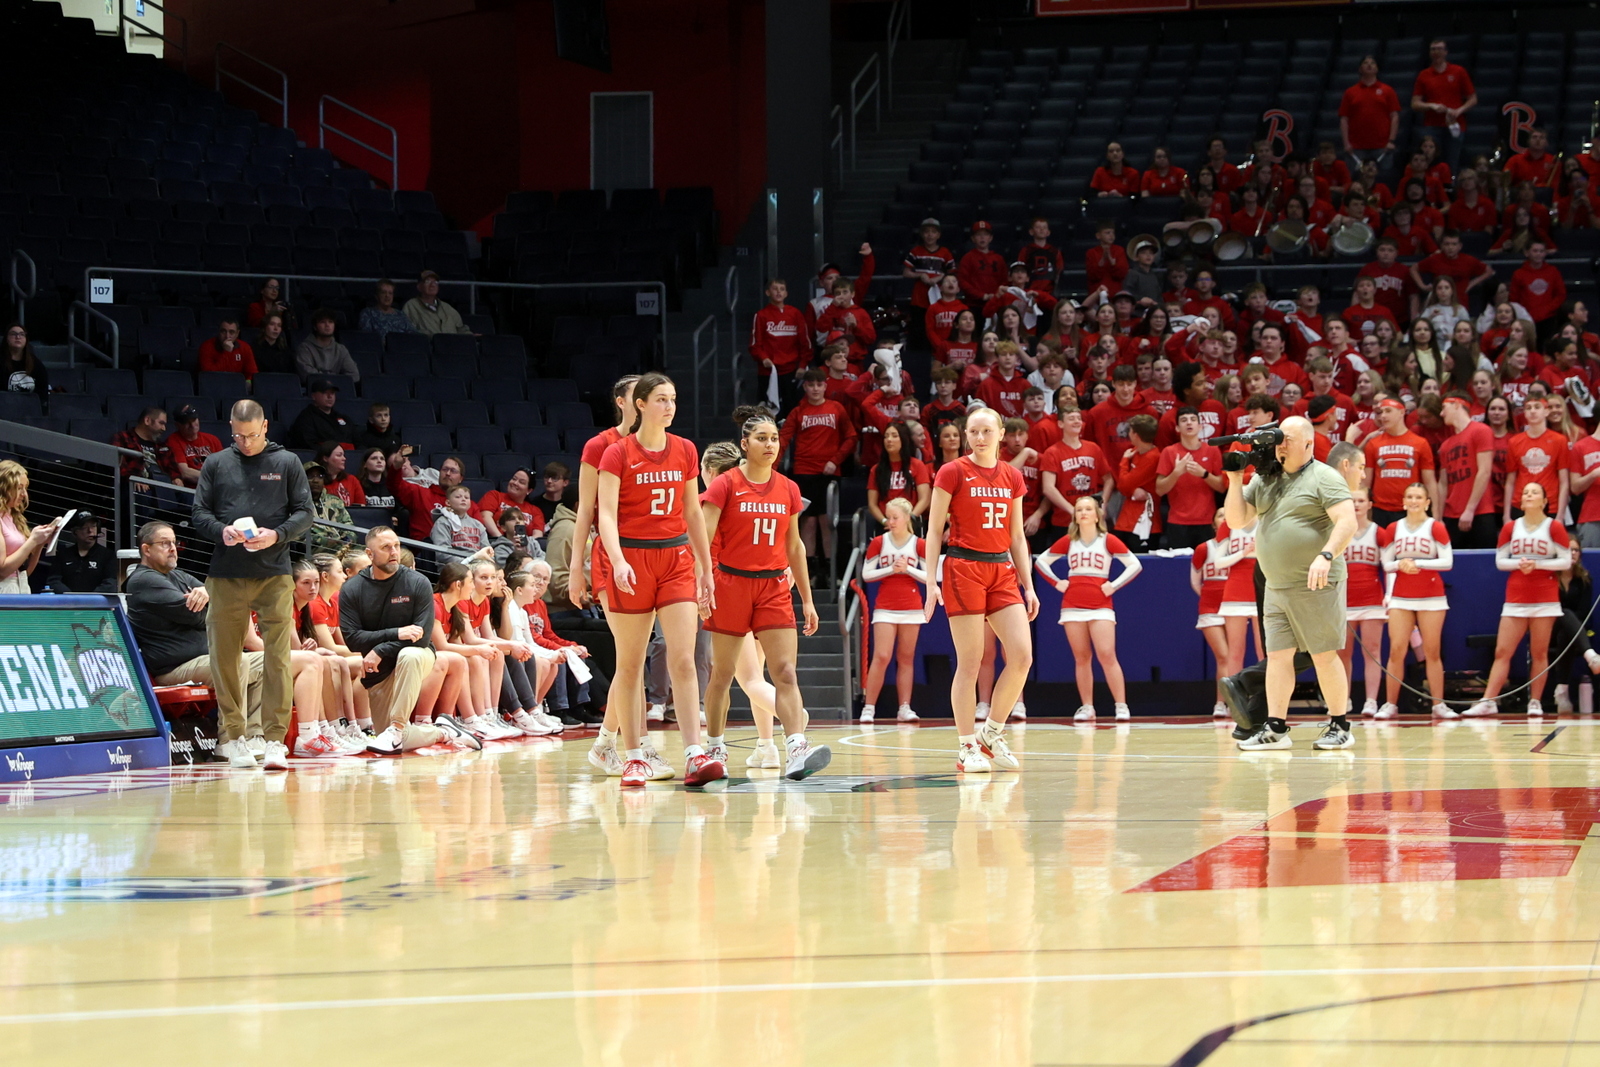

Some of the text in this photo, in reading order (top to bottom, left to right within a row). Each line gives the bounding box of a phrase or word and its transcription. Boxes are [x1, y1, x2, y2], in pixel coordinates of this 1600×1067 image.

[94, 286, 110, 295] 107
[639, 300, 656, 308] 107
[801, 414, 837, 431] REDMEN
[1378, 446, 1415, 457] BELLEVUE
[636, 470, 682, 484] BELLEVUE
[650, 487, 675, 515] 21
[970, 486, 1011, 499] BELLEVUE
[739, 501, 786, 515] BELLEVUE
[981, 502, 1008, 529] 32
[752, 517, 777, 546] 14
[1395, 536, 1431, 555] BHS
[1511, 538, 1548, 556] BHS
[1070, 552, 1105, 570] BHS
[0, 644, 90, 713] ENA
[77, 648, 136, 695] OHSAA
[17, 751, 35, 779] Kroger
[115, 745, 133, 774] Kroger
